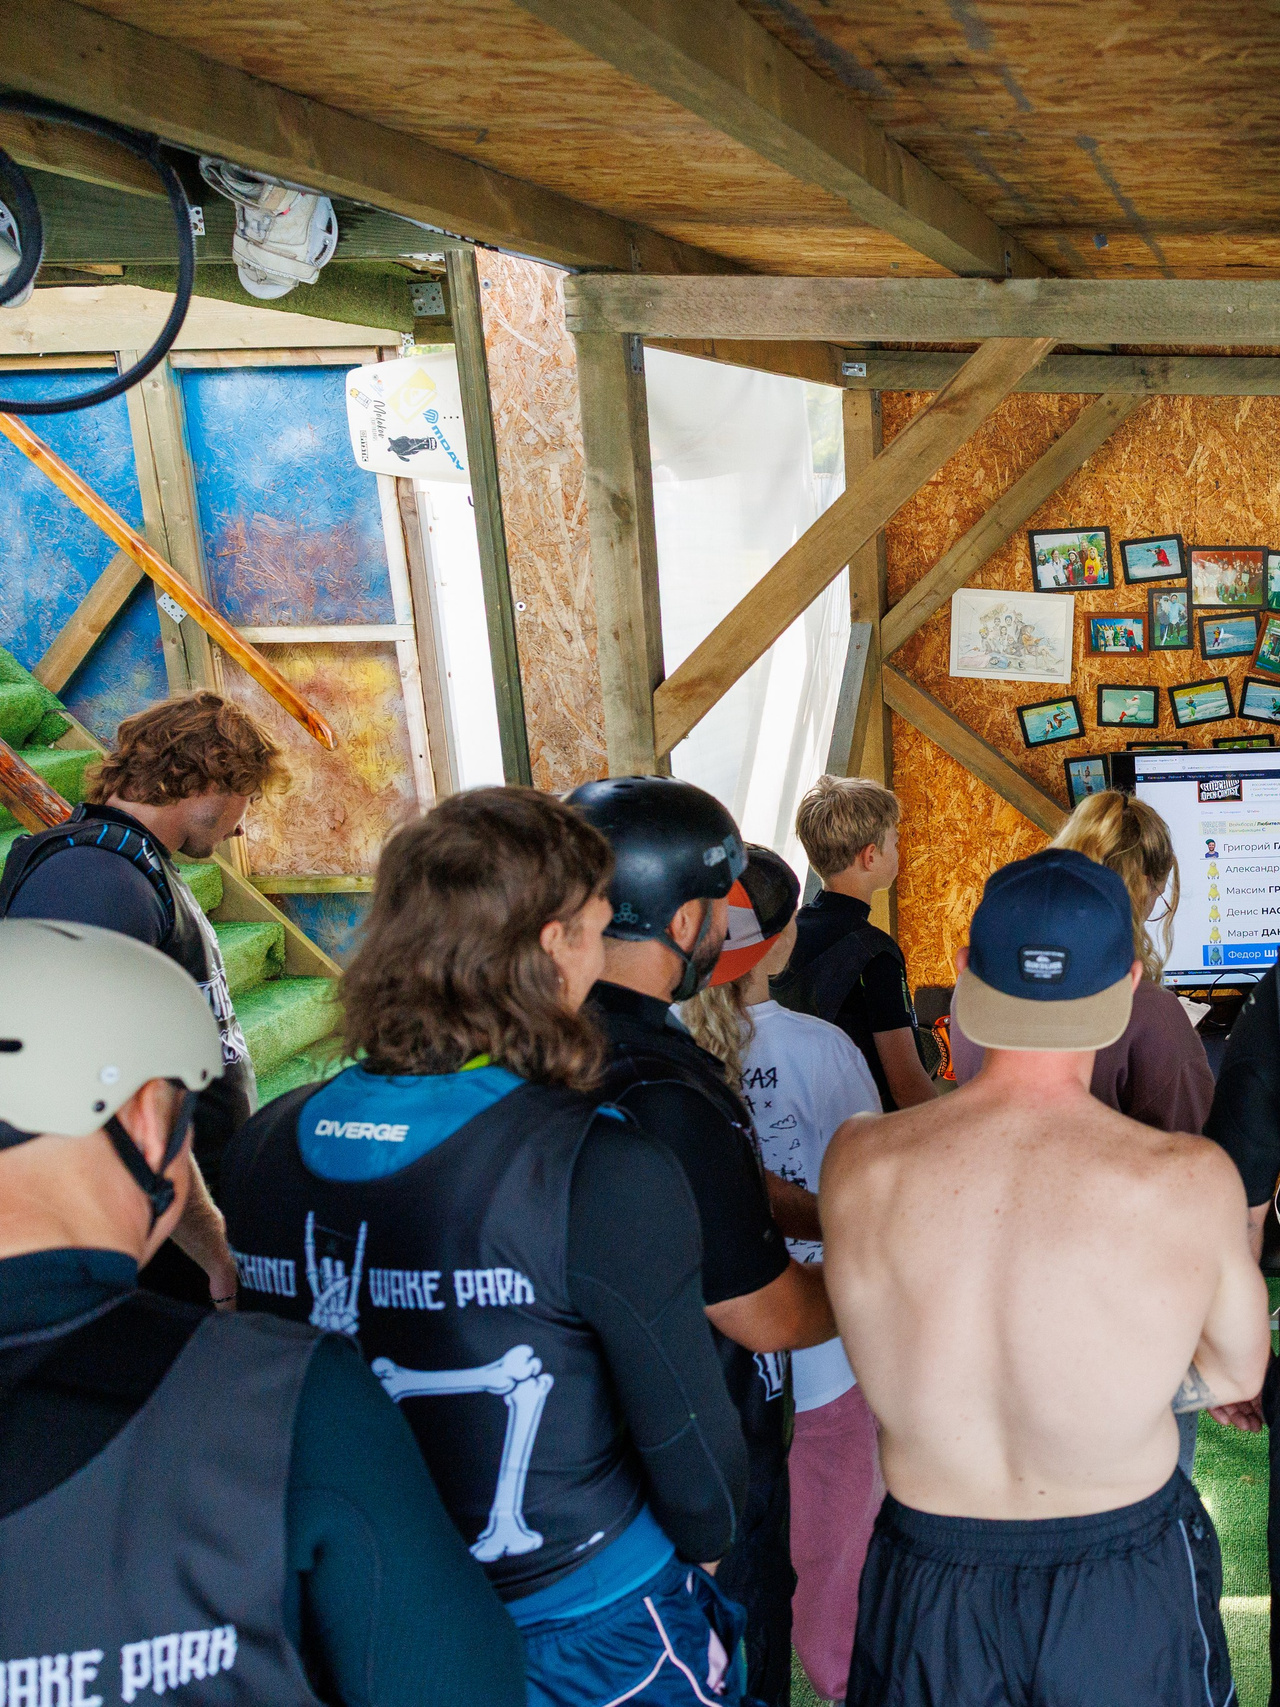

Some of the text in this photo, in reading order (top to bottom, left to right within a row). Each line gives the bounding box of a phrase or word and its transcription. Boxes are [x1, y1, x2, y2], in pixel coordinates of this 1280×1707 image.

[1200, 789, 1218, 801] OPEN
[1223, 841, 1271, 853] Григорий
[1225, 864, 1280, 874] Александр
[1226, 886, 1266, 895] Максим
[1226, 907, 1259, 918] Денис
[1227, 929, 1259, 938] Марат
[1228, 950, 1262, 960] Федор
[314, 1118, 410, 1143] DIVERGE
[368, 1267, 446, 1311] WAKE
[0, 1624, 239, 1707] AKE PARK
